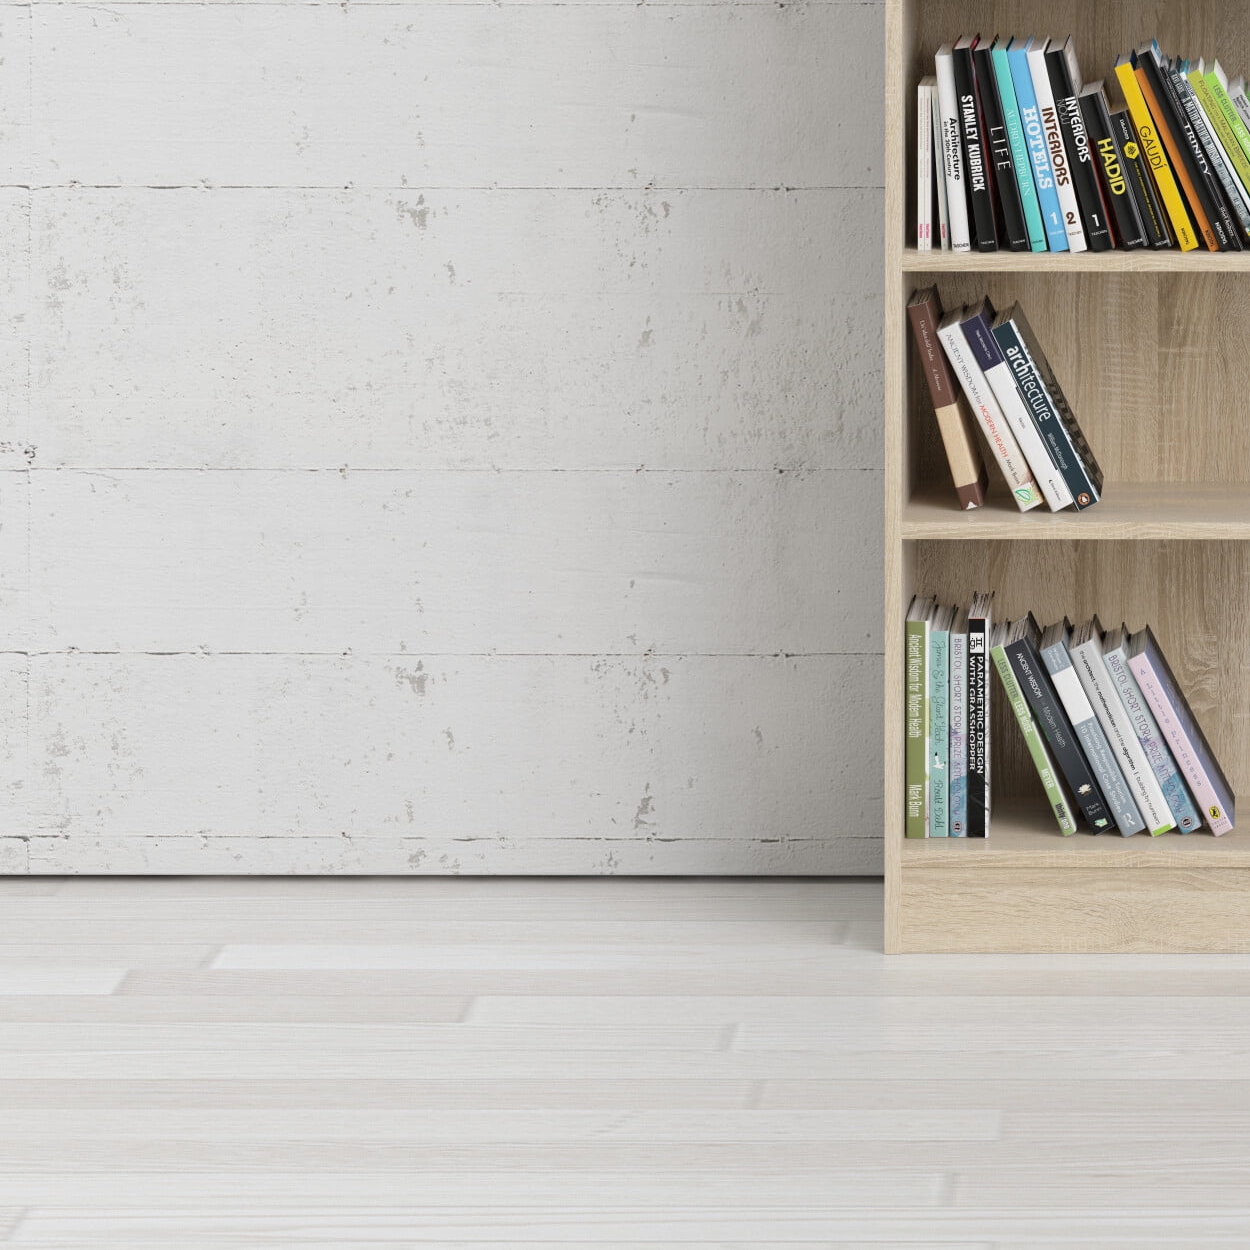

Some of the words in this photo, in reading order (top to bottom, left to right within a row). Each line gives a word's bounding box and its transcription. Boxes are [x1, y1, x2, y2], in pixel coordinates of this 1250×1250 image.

[1056, 98, 1070, 125] NOW
[1212, 84, 1224, 98] LESS
[960, 94, 978, 141] STANLEY
[1064, 95, 1090, 163] INTERIORS
[948, 117, 962, 180] Architecture
[990, 125, 1011, 171] LIFE
[1005, 106, 1021, 147] AUDREY
[1013, 146, 1031, 196] HEPBURN
[1021, 104, 1053, 190] HOTELS
[1041, 106, 1069, 186] INTERIORS
[1095, 137, 1127, 196] HADID
[1138, 123, 1166, 171] GAUDÍ
[1181, 121, 1212, 177] TRINITY
[967, 143, 984, 191] KUBRICK
[1050, 212, 1058, 226] 1
[1066, 212, 1076, 225] 2
[1092, 214, 1100, 227] 1
[945, 332, 964, 364] ANCIENT
[959, 364, 979, 396] WISDOM
[978, 403, 997, 434] MODERN
[992, 433, 1008, 458] HEALTH
[1004, 343, 1054, 422] architecture
[908, 634, 921, 656] Ancient
[930, 640, 944, 666] James
[908, 658, 921, 681] Wisdom
[908, 682, 921, 692] for
[933, 681, 942, 692] the
[996, 657, 1008, 673] LESS
[1013, 700, 1026, 716] LESS
[908, 694, 921, 716] Modern
[1015, 651, 1032, 676] ANCIENT
[1026, 674, 1043, 698] WISDOM
[1042, 705, 1058, 729] Modern
[1052, 728, 1067, 748] Health
[1107, 653, 1129, 686] BRISTOL
[1121, 686, 1141, 714] SHORT
[1134, 714, 1153, 742] STORY
[1146, 740, 1163, 764] PRIZE
[908, 718, 921, 737] Health
[1040, 767, 1055, 789] MEYER
[1120, 746, 1136, 771] algorithm
[908, 784, 921, 798] Mark
[908, 799, 921, 816] Bunn
[1101, 772, 1113, 789] Case
[1108, 789, 1124, 813] Studies
